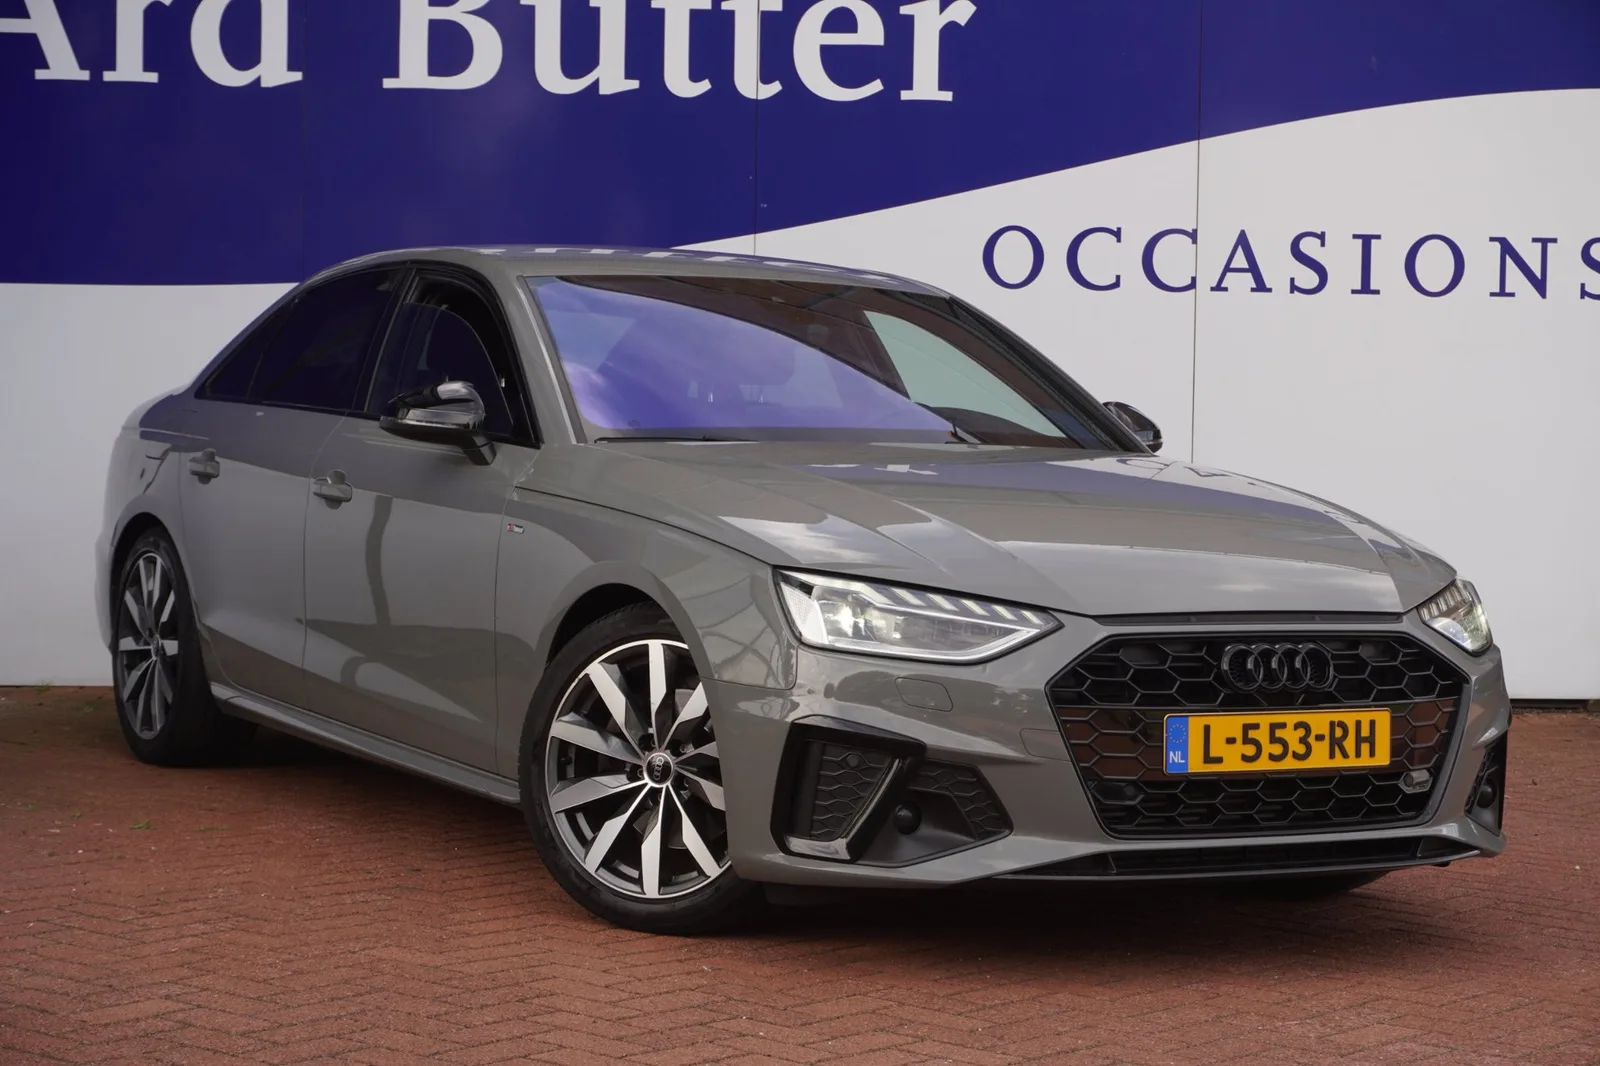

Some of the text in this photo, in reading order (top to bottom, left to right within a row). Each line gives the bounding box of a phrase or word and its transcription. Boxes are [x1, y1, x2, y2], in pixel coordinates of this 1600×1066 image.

[382, 0, 977, 101] Butter
[982, 224, 1600, 301] OCCASIONS
[1169, 751, 1185, 764] NL
[1203, 719, 1376, 765] L-553-RH
